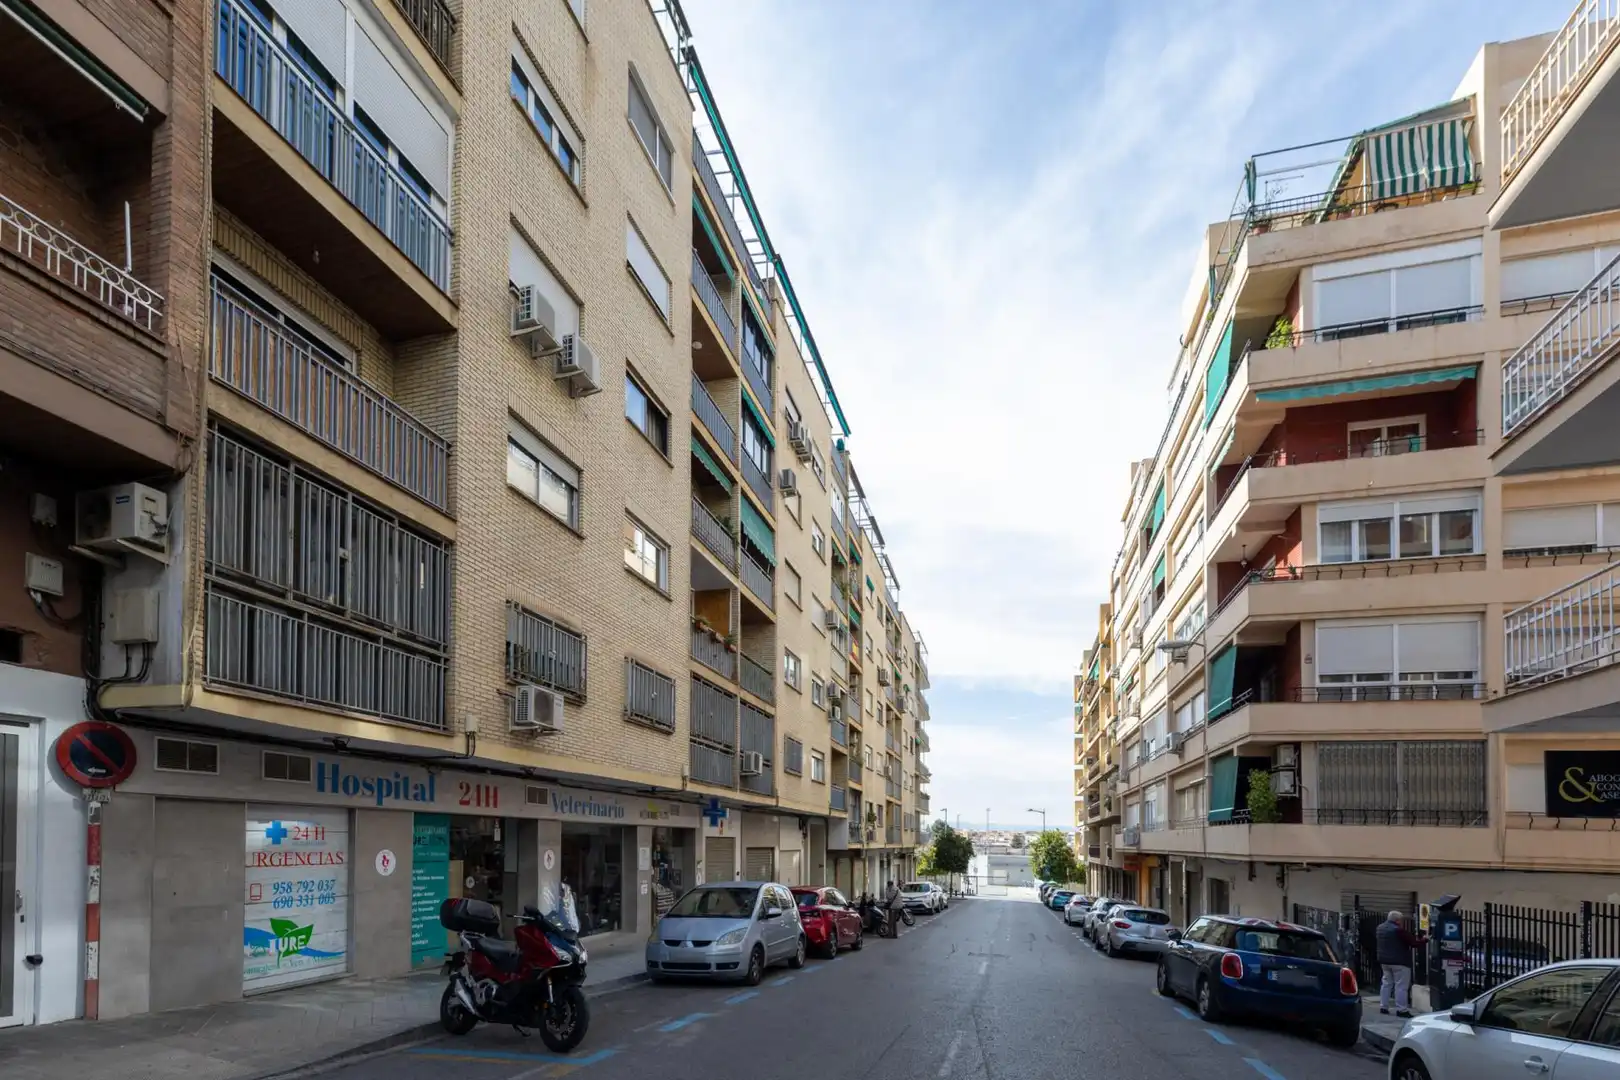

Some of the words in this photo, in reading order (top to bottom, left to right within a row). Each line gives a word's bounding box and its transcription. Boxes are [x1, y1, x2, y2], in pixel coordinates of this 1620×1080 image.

[317, 761, 435, 806] Hospital
[551, 792, 625, 819] Veterinario
[272, 881, 293, 895] 958
[296, 880, 315, 893] 792
[317, 879, 337, 892] 037
[273, 896, 294, 909] 690
[296, 895, 315, 907] 331
[318, 893, 336, 905] 005
[1445, 923, 1458, 936] P
